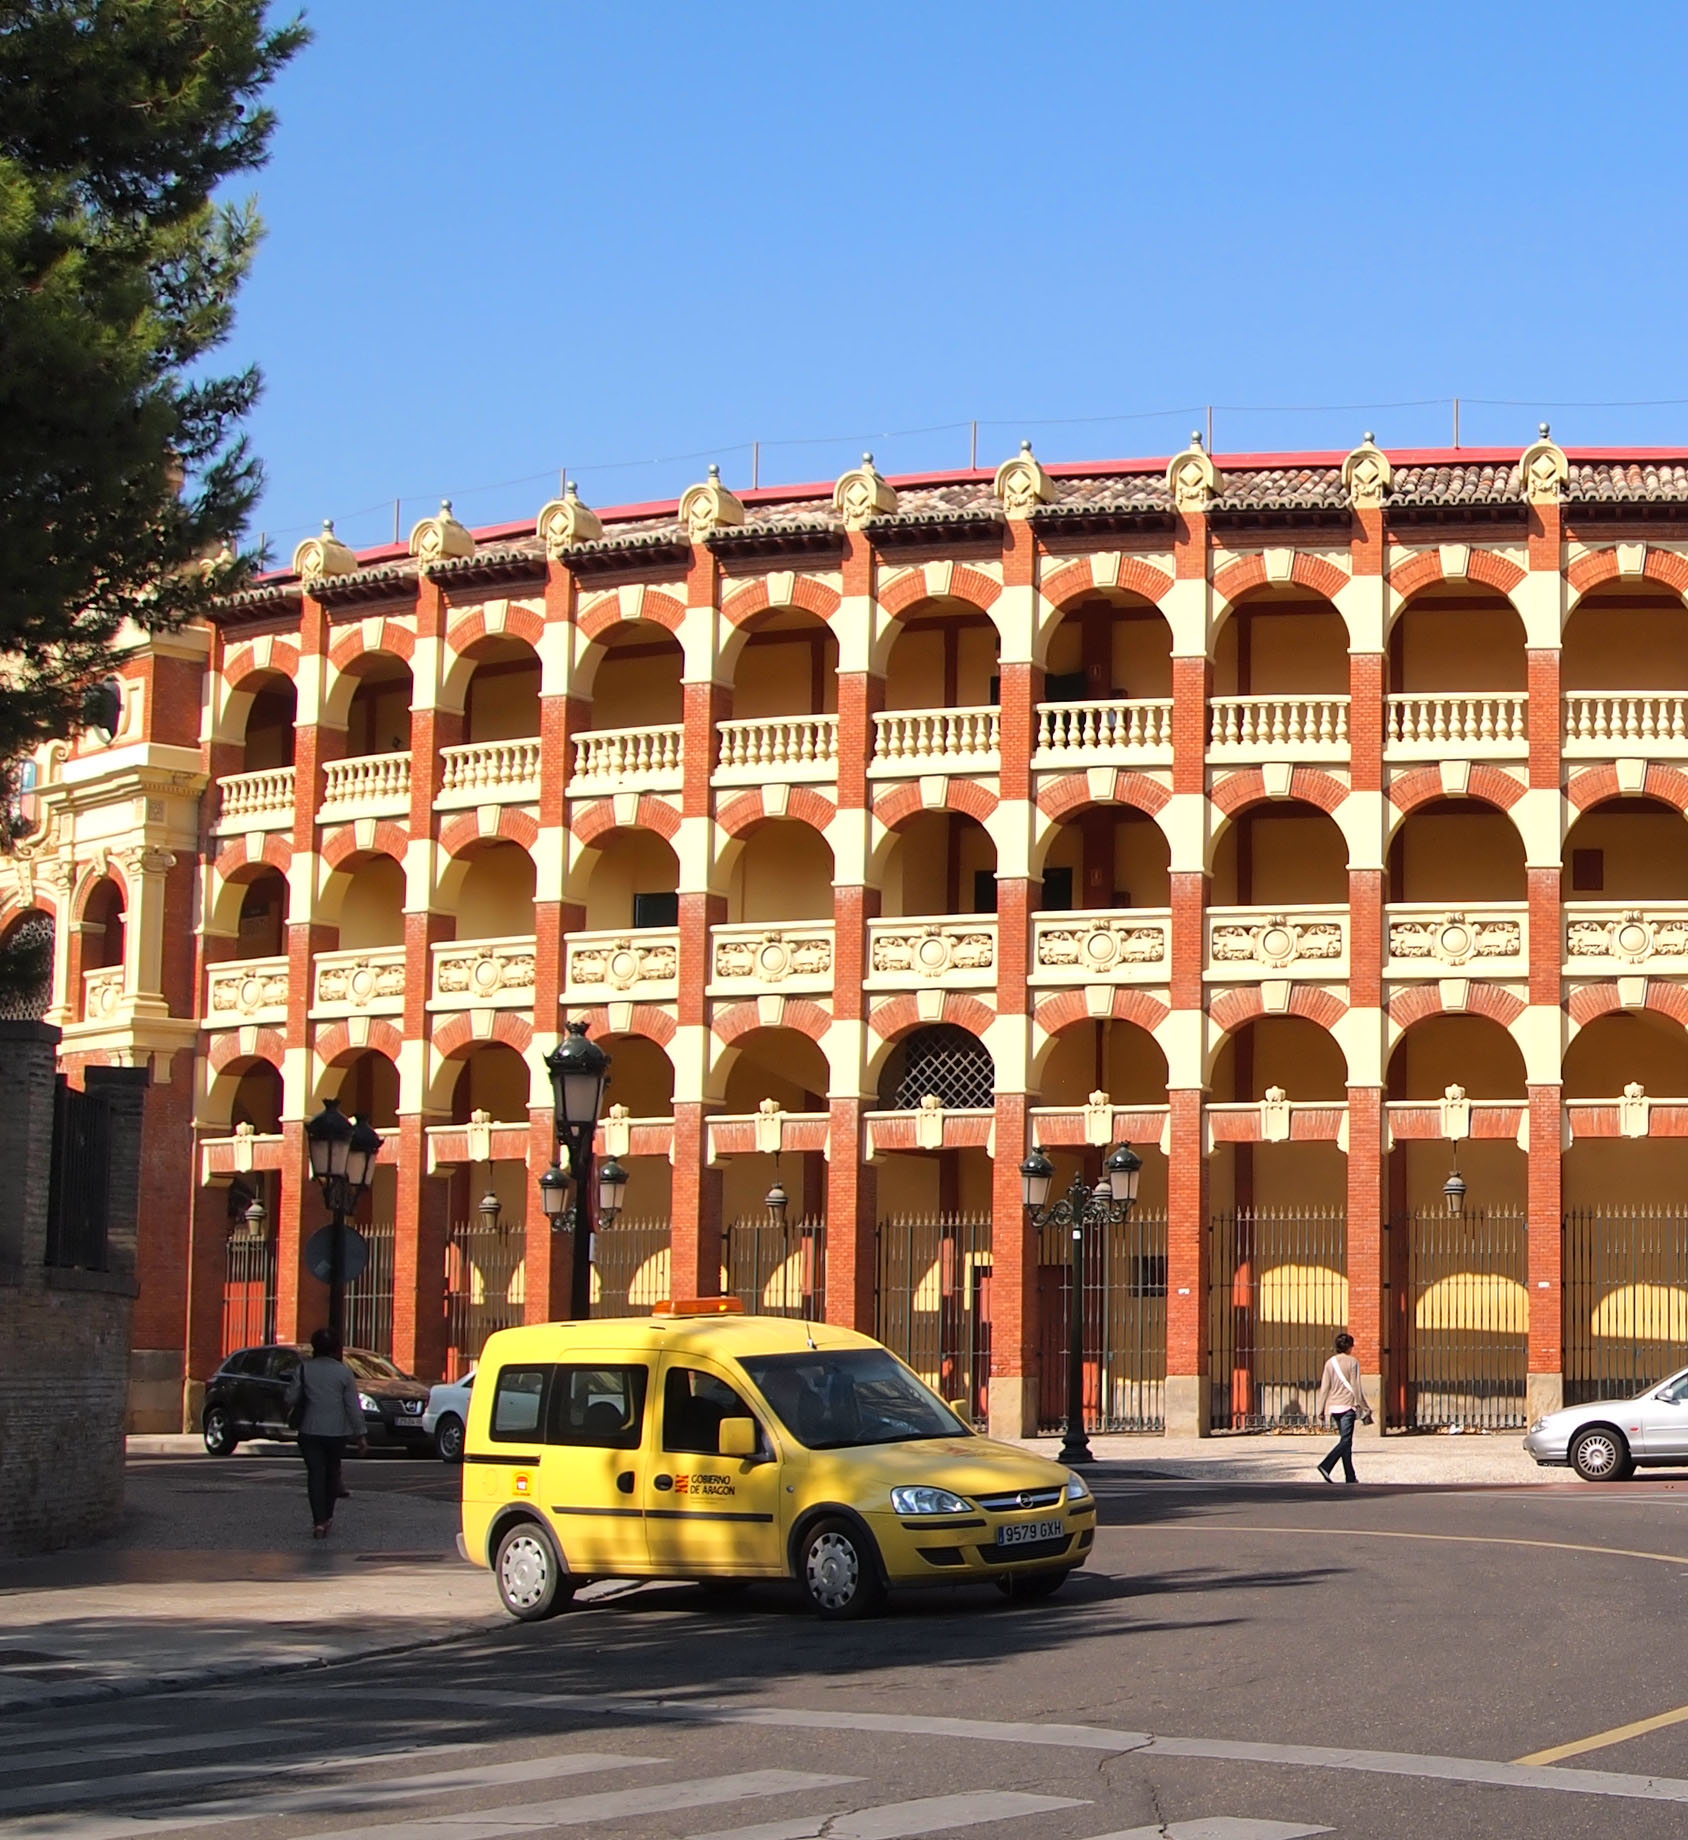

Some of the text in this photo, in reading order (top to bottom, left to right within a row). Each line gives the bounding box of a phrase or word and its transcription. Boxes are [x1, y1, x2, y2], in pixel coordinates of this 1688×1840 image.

[691, 1474, 731, 1485] GOBIERNO
[690, 1485, 700, 1495] DE
[1005, 1520, 1061, 1542] 9579 GXH
